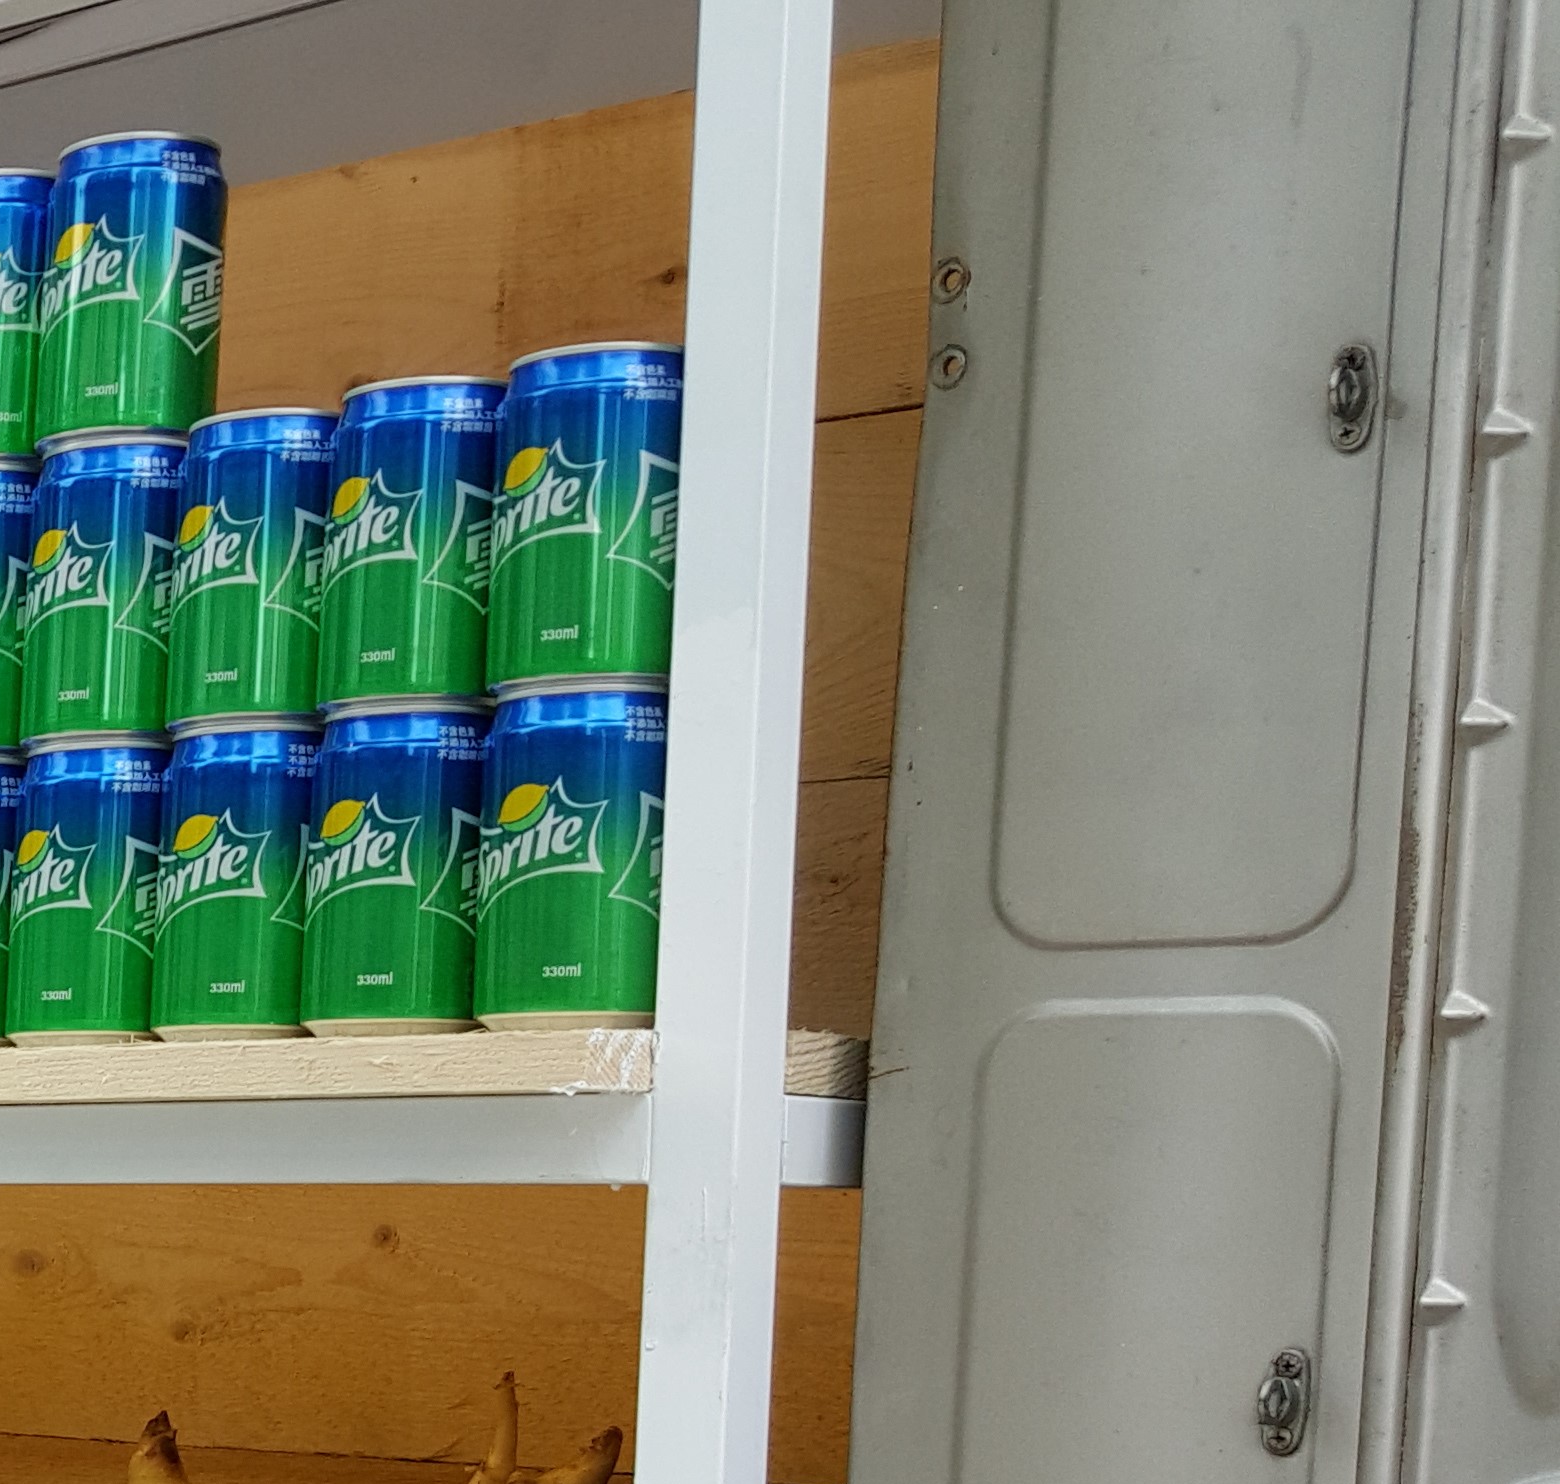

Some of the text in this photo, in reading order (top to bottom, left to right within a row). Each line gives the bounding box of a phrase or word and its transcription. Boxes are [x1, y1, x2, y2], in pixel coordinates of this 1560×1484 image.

[40, 239, 121, 323] prite
[491, 471, 581, 561] prite
[323, 504, 398, 573] prite
[26, 547, 93, 627] prite
[540, 625, 578, 642] 330ml
[361, 648, 395, 663] 330ml
[58, 688, 89, 701] 330ml
[11, 856, 74, 920] prite
[357, 972, 393, 986] 330ml
[543, 963, 581, 979] 330ml
[41, 988, 71, 1001] 330ml
[210, 980, 245, 995] 330ml
